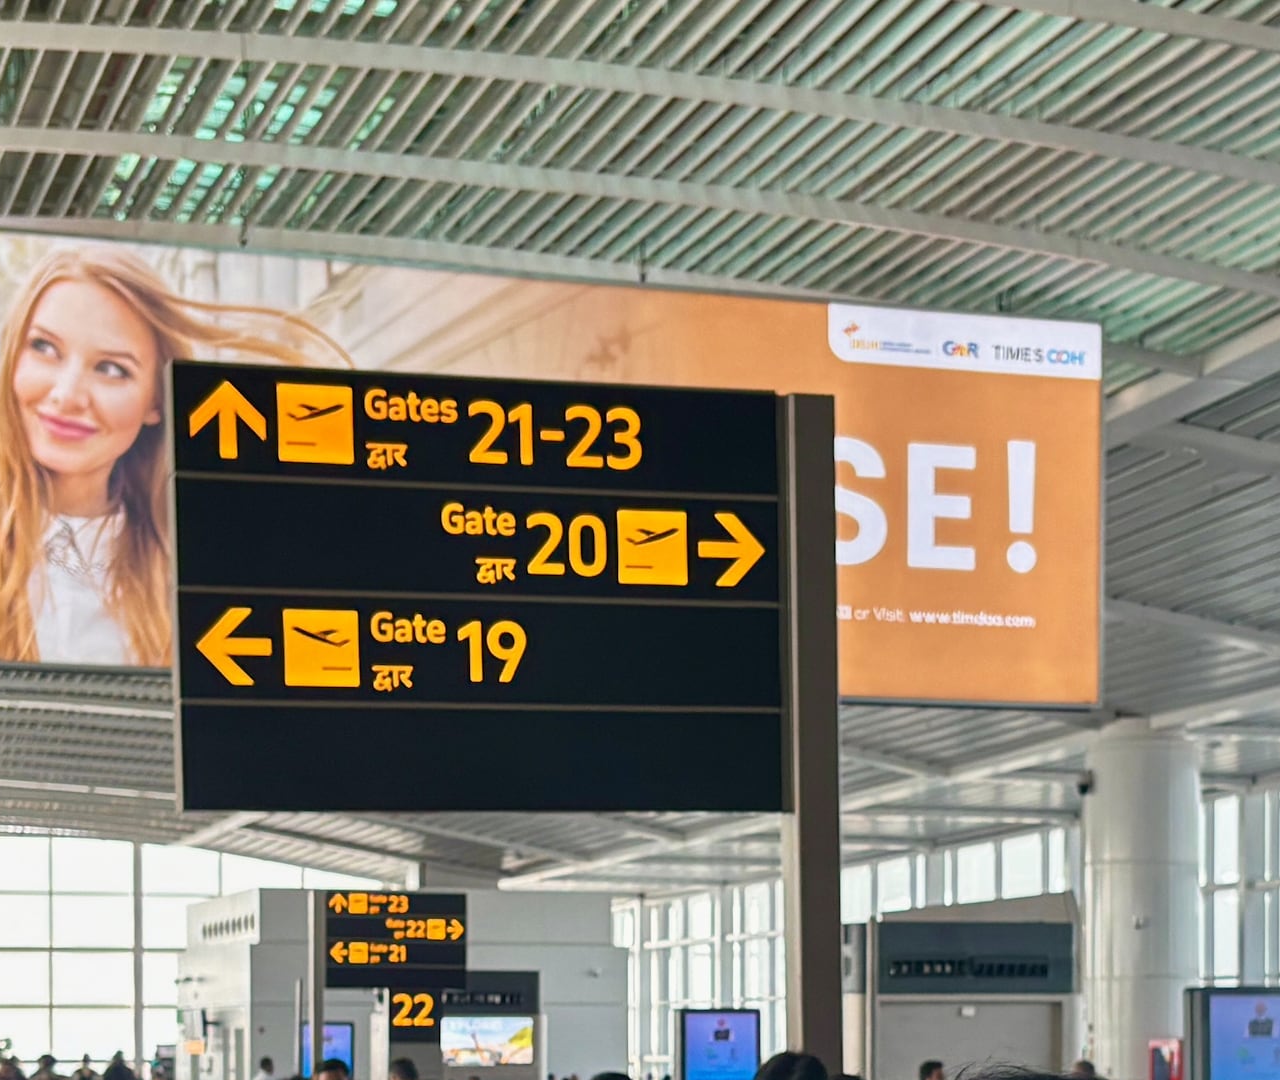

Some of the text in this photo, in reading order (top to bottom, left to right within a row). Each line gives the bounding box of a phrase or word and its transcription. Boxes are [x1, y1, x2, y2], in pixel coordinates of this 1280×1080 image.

[993, 344, 1043, 363] TIMES
[364, 388, 643, 470] Gates 21-23
[365, 442, 408, 470] द्वार
[440, 502, 608, 577] Gate 20
[475, 557, 517, 585] द्वार
[370, 611, 527, 683] Gate 19
[371, 664, 414, 692] द्वार
[387, 894, 409, 914] 23
[406, 920, 426, 938] 22
[388, 944, 407, 962] 21
[392, 993, 435, 1027] 22
